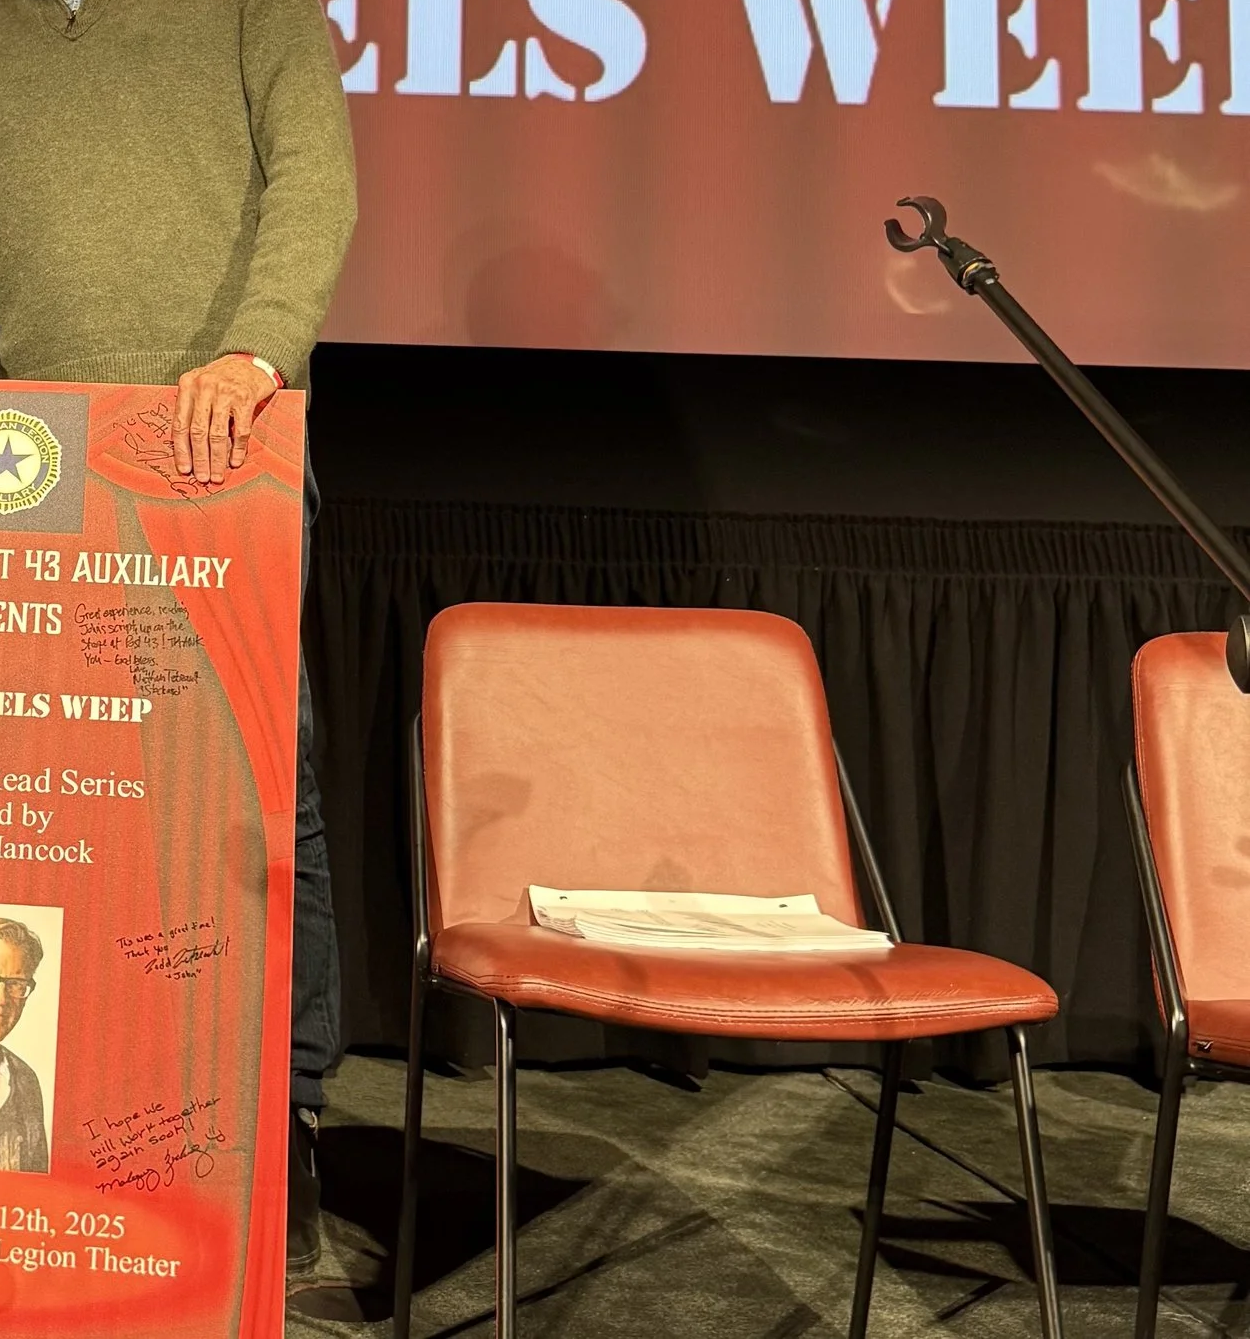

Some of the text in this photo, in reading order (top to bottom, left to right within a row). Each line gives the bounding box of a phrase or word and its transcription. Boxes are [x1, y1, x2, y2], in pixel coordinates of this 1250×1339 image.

[20, 425, 50, 464] LEGION
[25, 549, 61, 582] 43
[71, 551, 232, 588] AUXILIARY
[59, 694, 153, 723] WEEP
[60, 768, 146, 799] Series
[21, 803, 55, 834] by
[63, 1210, 126, 1240] 2025
[83, 1245, 182, 1278] Theater
